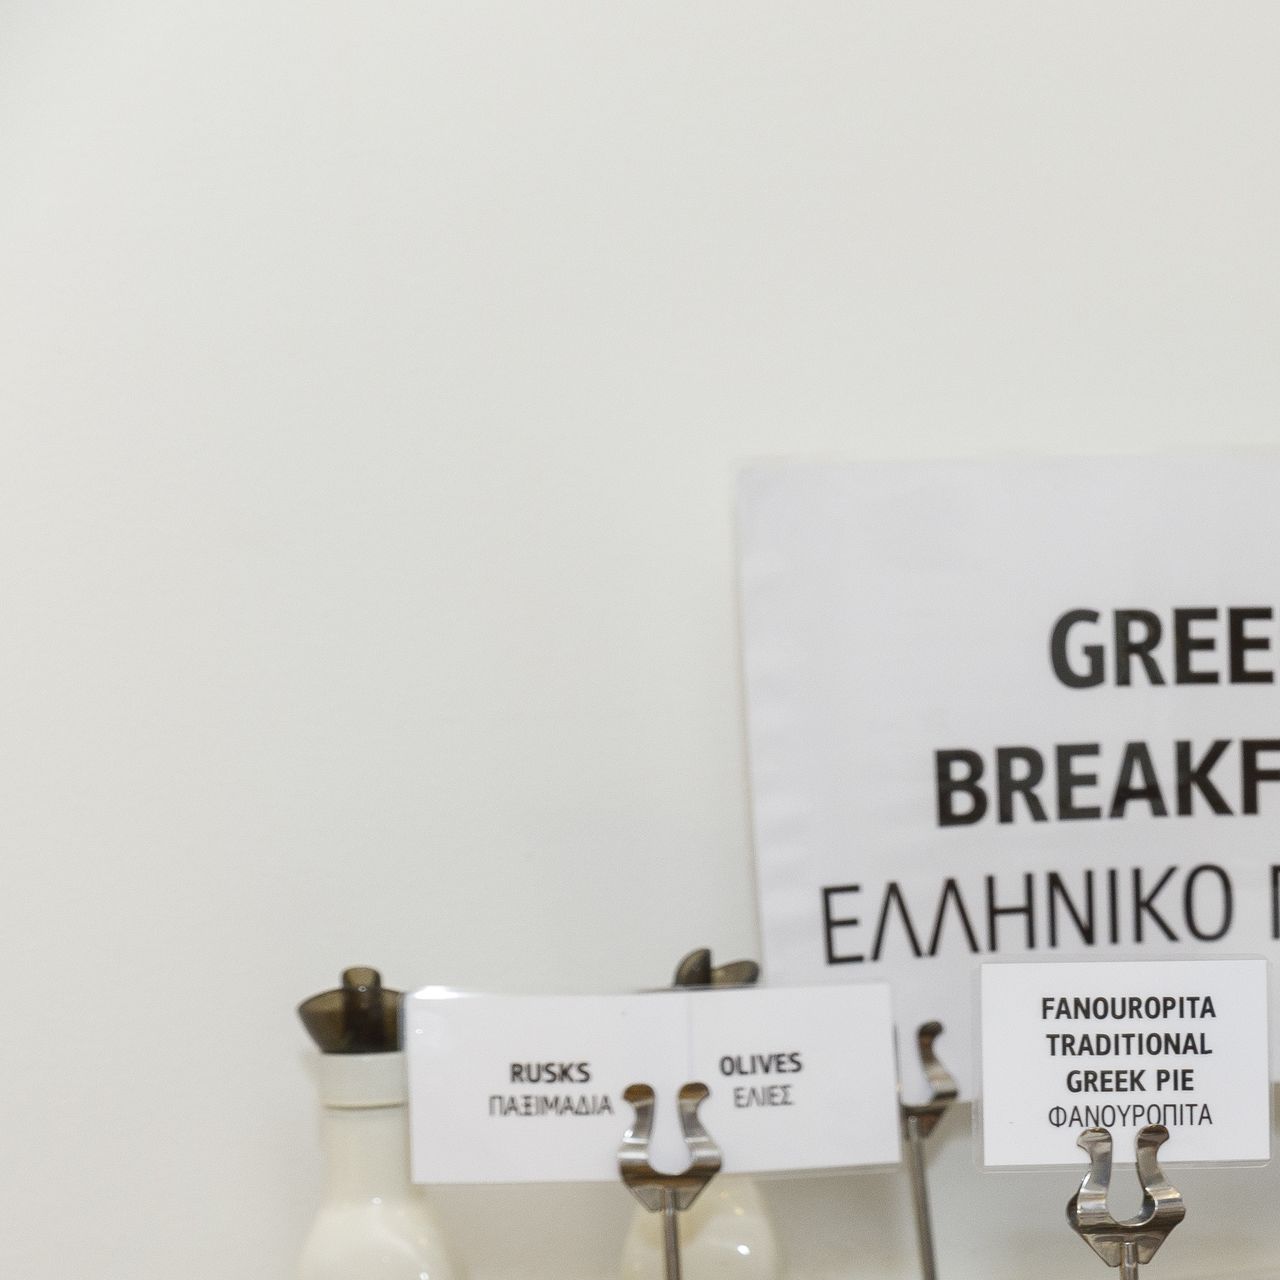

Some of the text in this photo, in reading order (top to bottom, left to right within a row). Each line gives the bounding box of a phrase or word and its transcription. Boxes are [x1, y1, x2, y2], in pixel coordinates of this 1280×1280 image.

[821, 864, 1234, 966] ΕΛΛΗΝΙΚΟ
[1042, 995, 1216, 1020] FANOUROPITA
[1046, 1032, 1213, 1056] TRADITIONAL
[510, 1062, 591, 1084] RUSKS
[719, 1051, 803, 1078] OLIVES
[1066, 1069, 1194, 1093] GREEK PIE
[489, 1094, 614, 1117] ΠΑΞΙΜΑΔΙΑ
[733, 1083, 794, 1109] ΕΛΙΕΣ
[1048, 1103, 1213, 1128] ΦΑΝΟΥΡΟΠΙΤΑ
